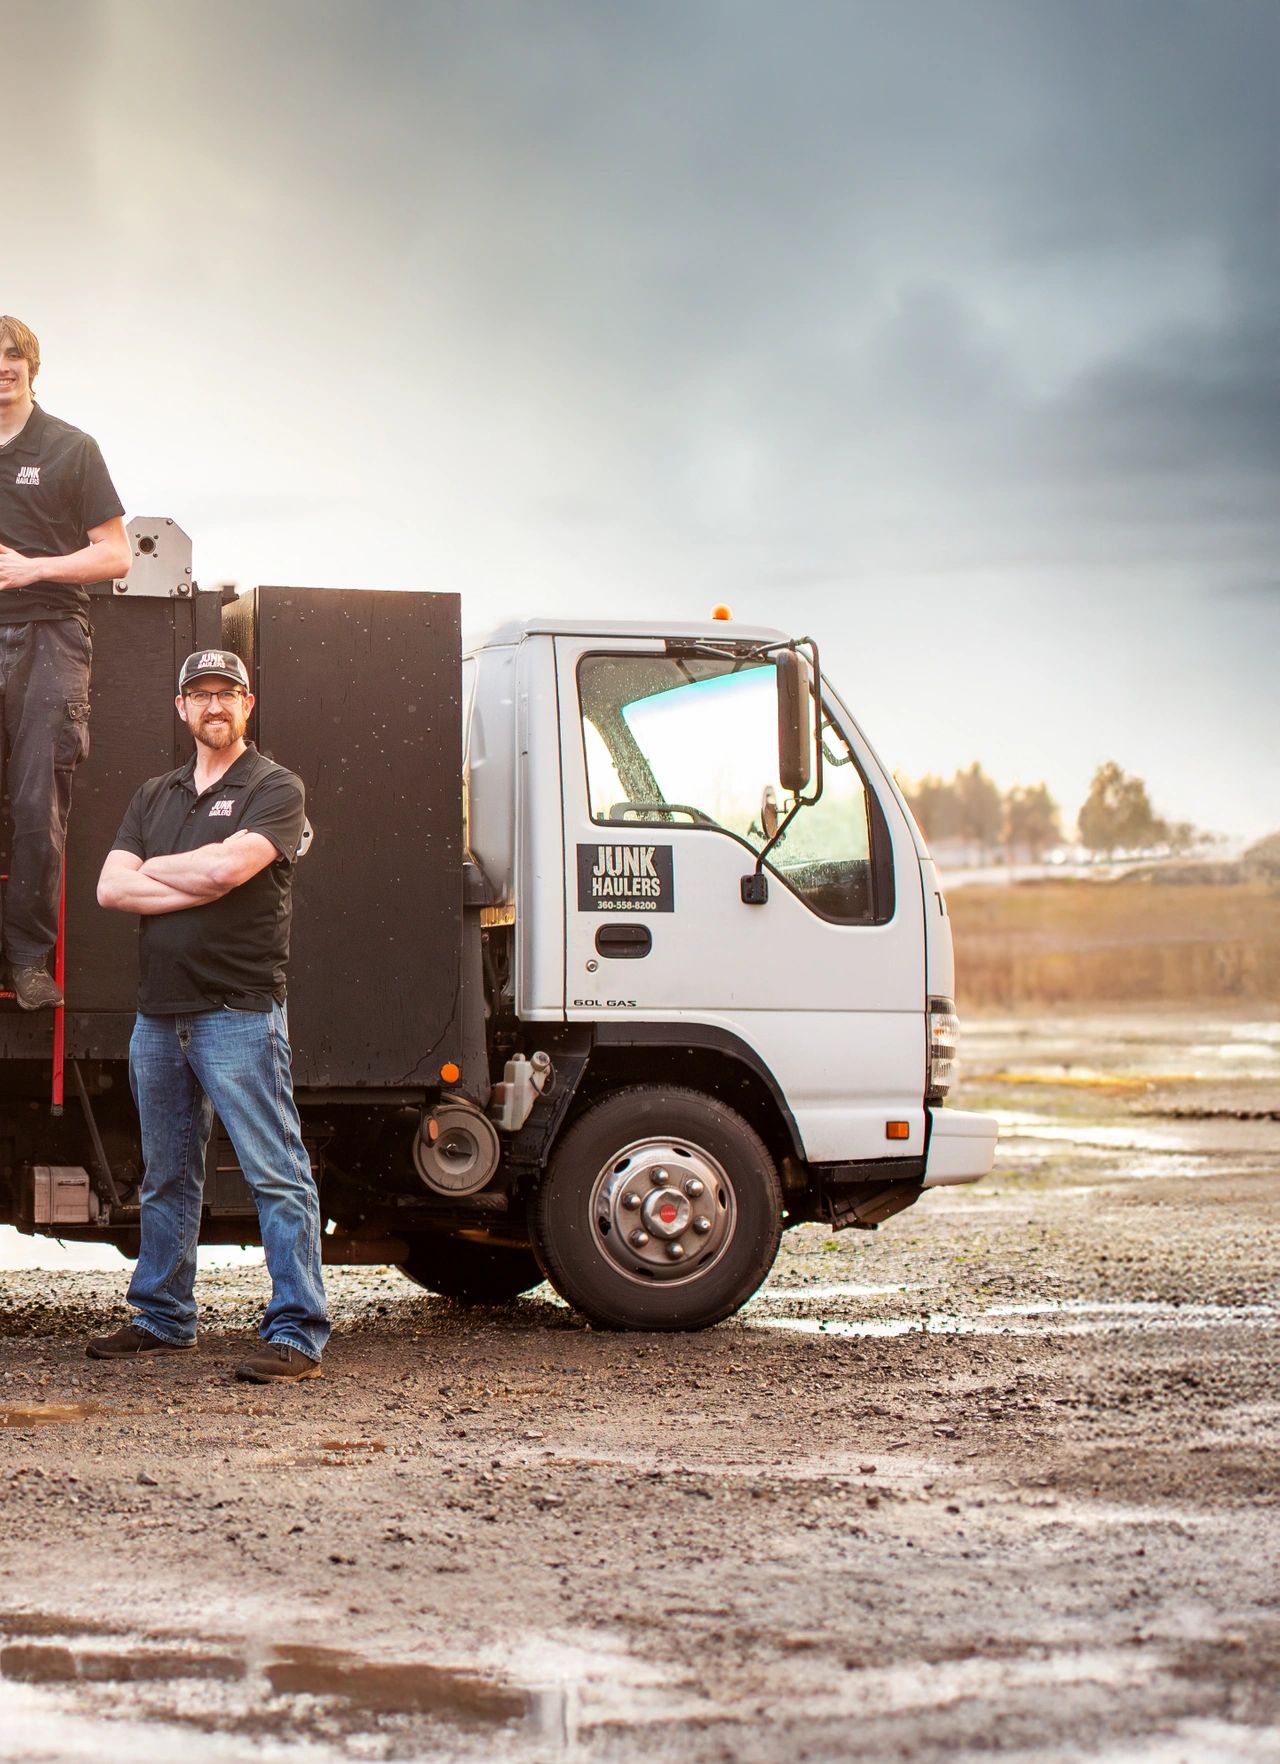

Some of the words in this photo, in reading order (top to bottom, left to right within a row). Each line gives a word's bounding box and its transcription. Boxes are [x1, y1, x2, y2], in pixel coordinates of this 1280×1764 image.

[17, 466, 40, 479] JUNK
[200, 652, 224, 664] JUNK
[211, 799, 235, 811] JUNK
[592, 846, 658, 877] JUNK
[592, 877, 661, 897] HAULERS
[597, 900, 657, 910] 360-558-8200
[606, 1000, 637, 1008] GAS
